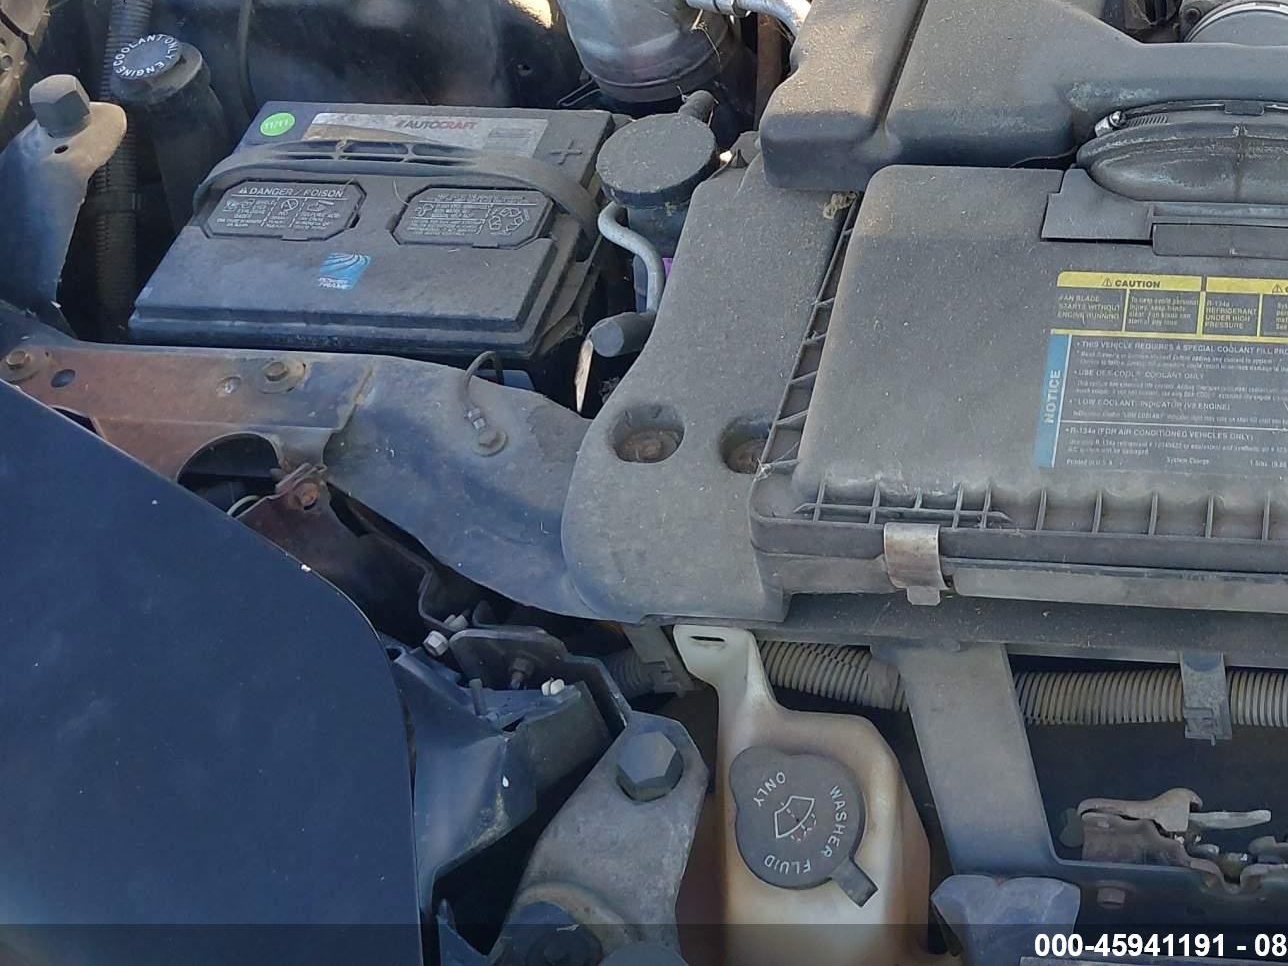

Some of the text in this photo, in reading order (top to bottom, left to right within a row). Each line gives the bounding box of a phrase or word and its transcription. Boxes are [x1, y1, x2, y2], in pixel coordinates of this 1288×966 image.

[112, 34, 179, 77] ENGINE COOLANT ONLY
[404, 120, 477, 130] AUTOCRAFT
[249, 187, 294, 196] DANGER
[303, 188, 344, 198] POISON
[1114, 279, 1161, 289] CAUTION
[1088, 304, 1120, 312] WITHOUT
[1206, 306, 1258, 315] REFRIGERANT
[1205, 314, 1231, 322] UNDER
[1101, 341, 1133, 350] VEHICLE
[1135, 342, 1174, 351] REQUIRES
[1183, 344, 1214, 353] SPECIAL
[1217, 345, 1254, 354] COOLANT
[1184, 372, 1205, 380] ONLY
[1044, 370, 1061, 424] NOTICE
[1140, 400, 1183, 410] INDICATOR
[1097, 427, 1117, 436] (FOR
[1118, 428, 1132, 437] AIR
[1134, 428, 1188, 438] CONDITIONED
[1189, 430, 1228, 439] VEHICLES
[753, 771, 848, 875] WASHER FLUID ONLY
